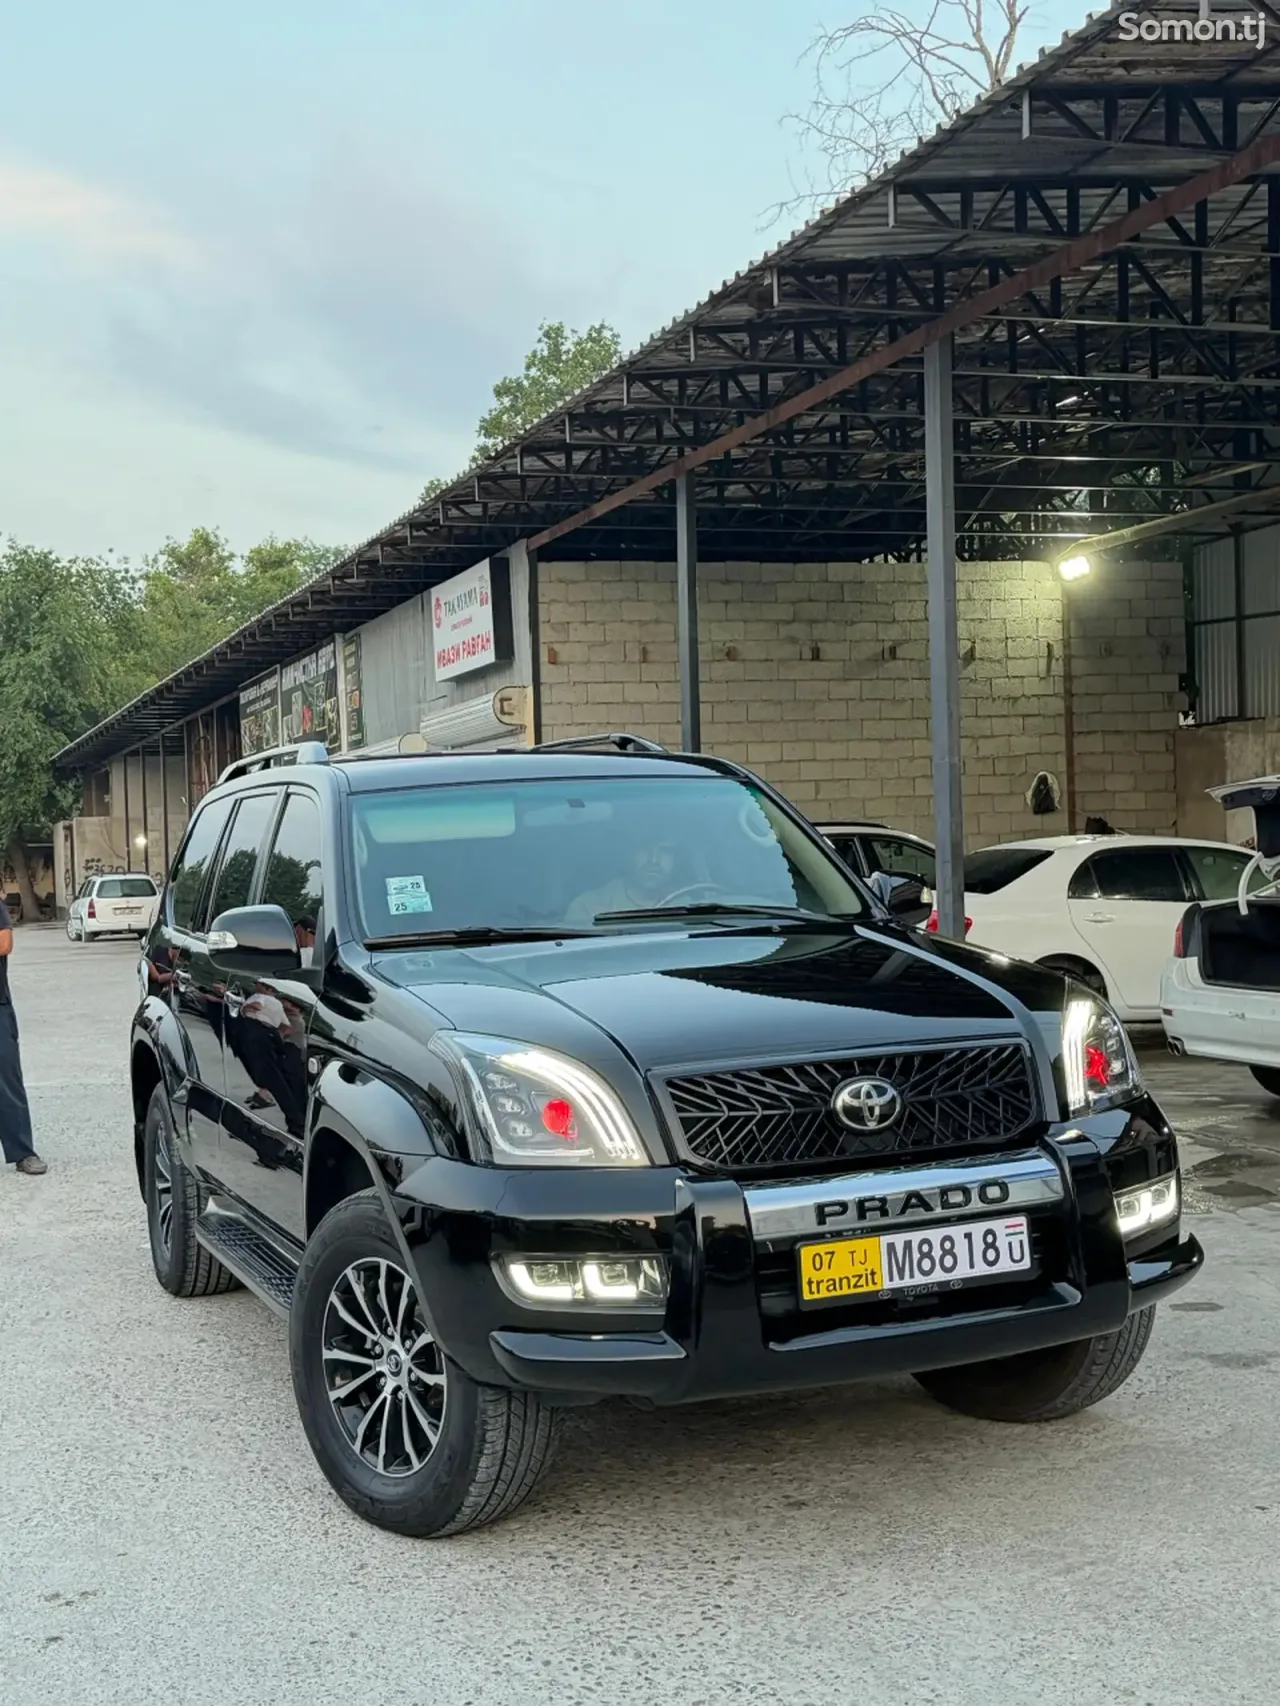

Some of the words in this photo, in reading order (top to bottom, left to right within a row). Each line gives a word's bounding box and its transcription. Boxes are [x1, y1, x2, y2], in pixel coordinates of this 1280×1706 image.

[394, 902, 408, 912] 25
[814, 1178, 1010, 1226] PRADO
[812, 1250, 836, 1272] 07
[848, 1248, 868, 1268] TJ
[886, 1228, 1001, 1282] M8818
[1008, 1239, 1025, 1264] U
[807, 1267, 878, 1296] tranzit
[903, 1283, 940, 1296] TOYOTA
